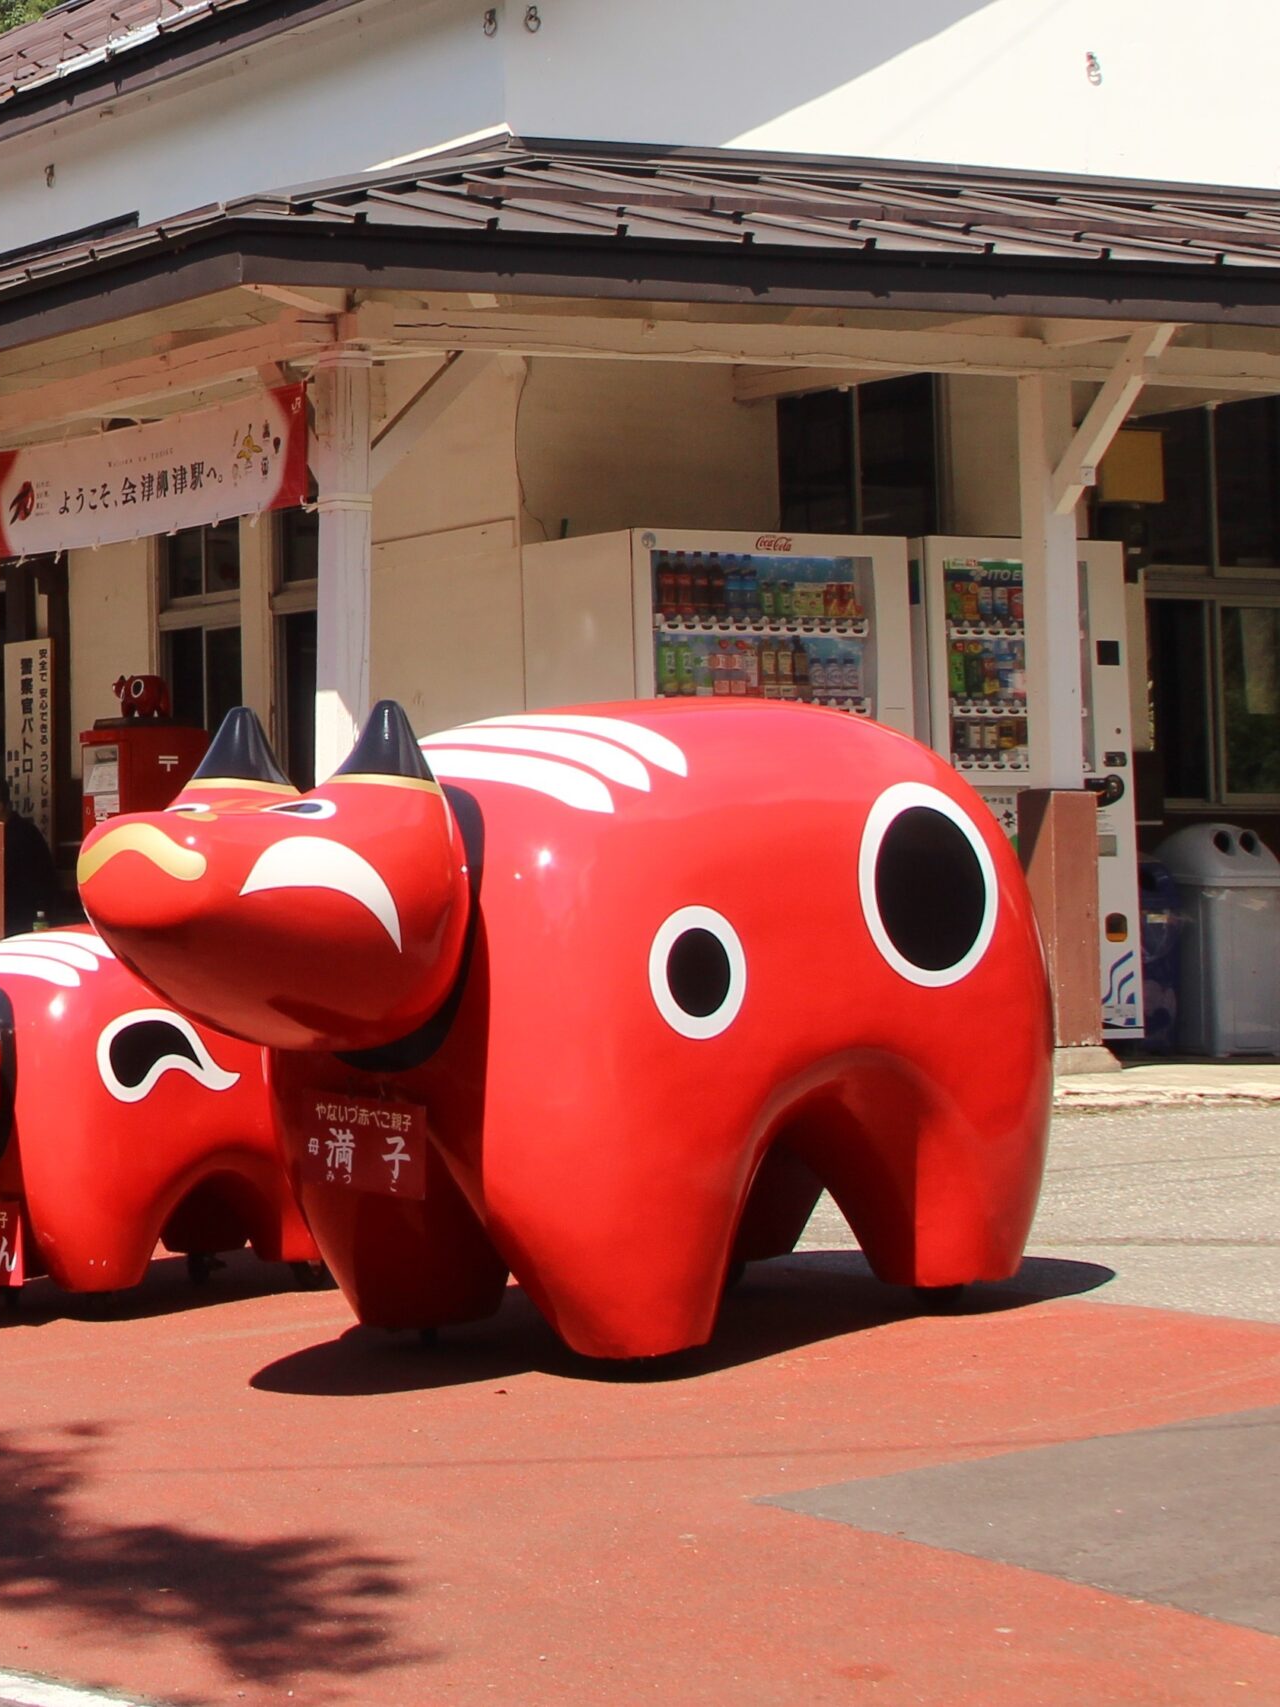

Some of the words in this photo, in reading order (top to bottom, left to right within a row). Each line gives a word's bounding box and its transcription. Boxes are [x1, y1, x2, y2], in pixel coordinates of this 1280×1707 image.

[59, 461, 223, 515] ようこそ、会津柳津駅へ。
[987, 569, 1011, 581] ITO
[315, 1102, 412, 1133] やないづ赤べこ親子
[307, 1137, 320, 1156] 母
